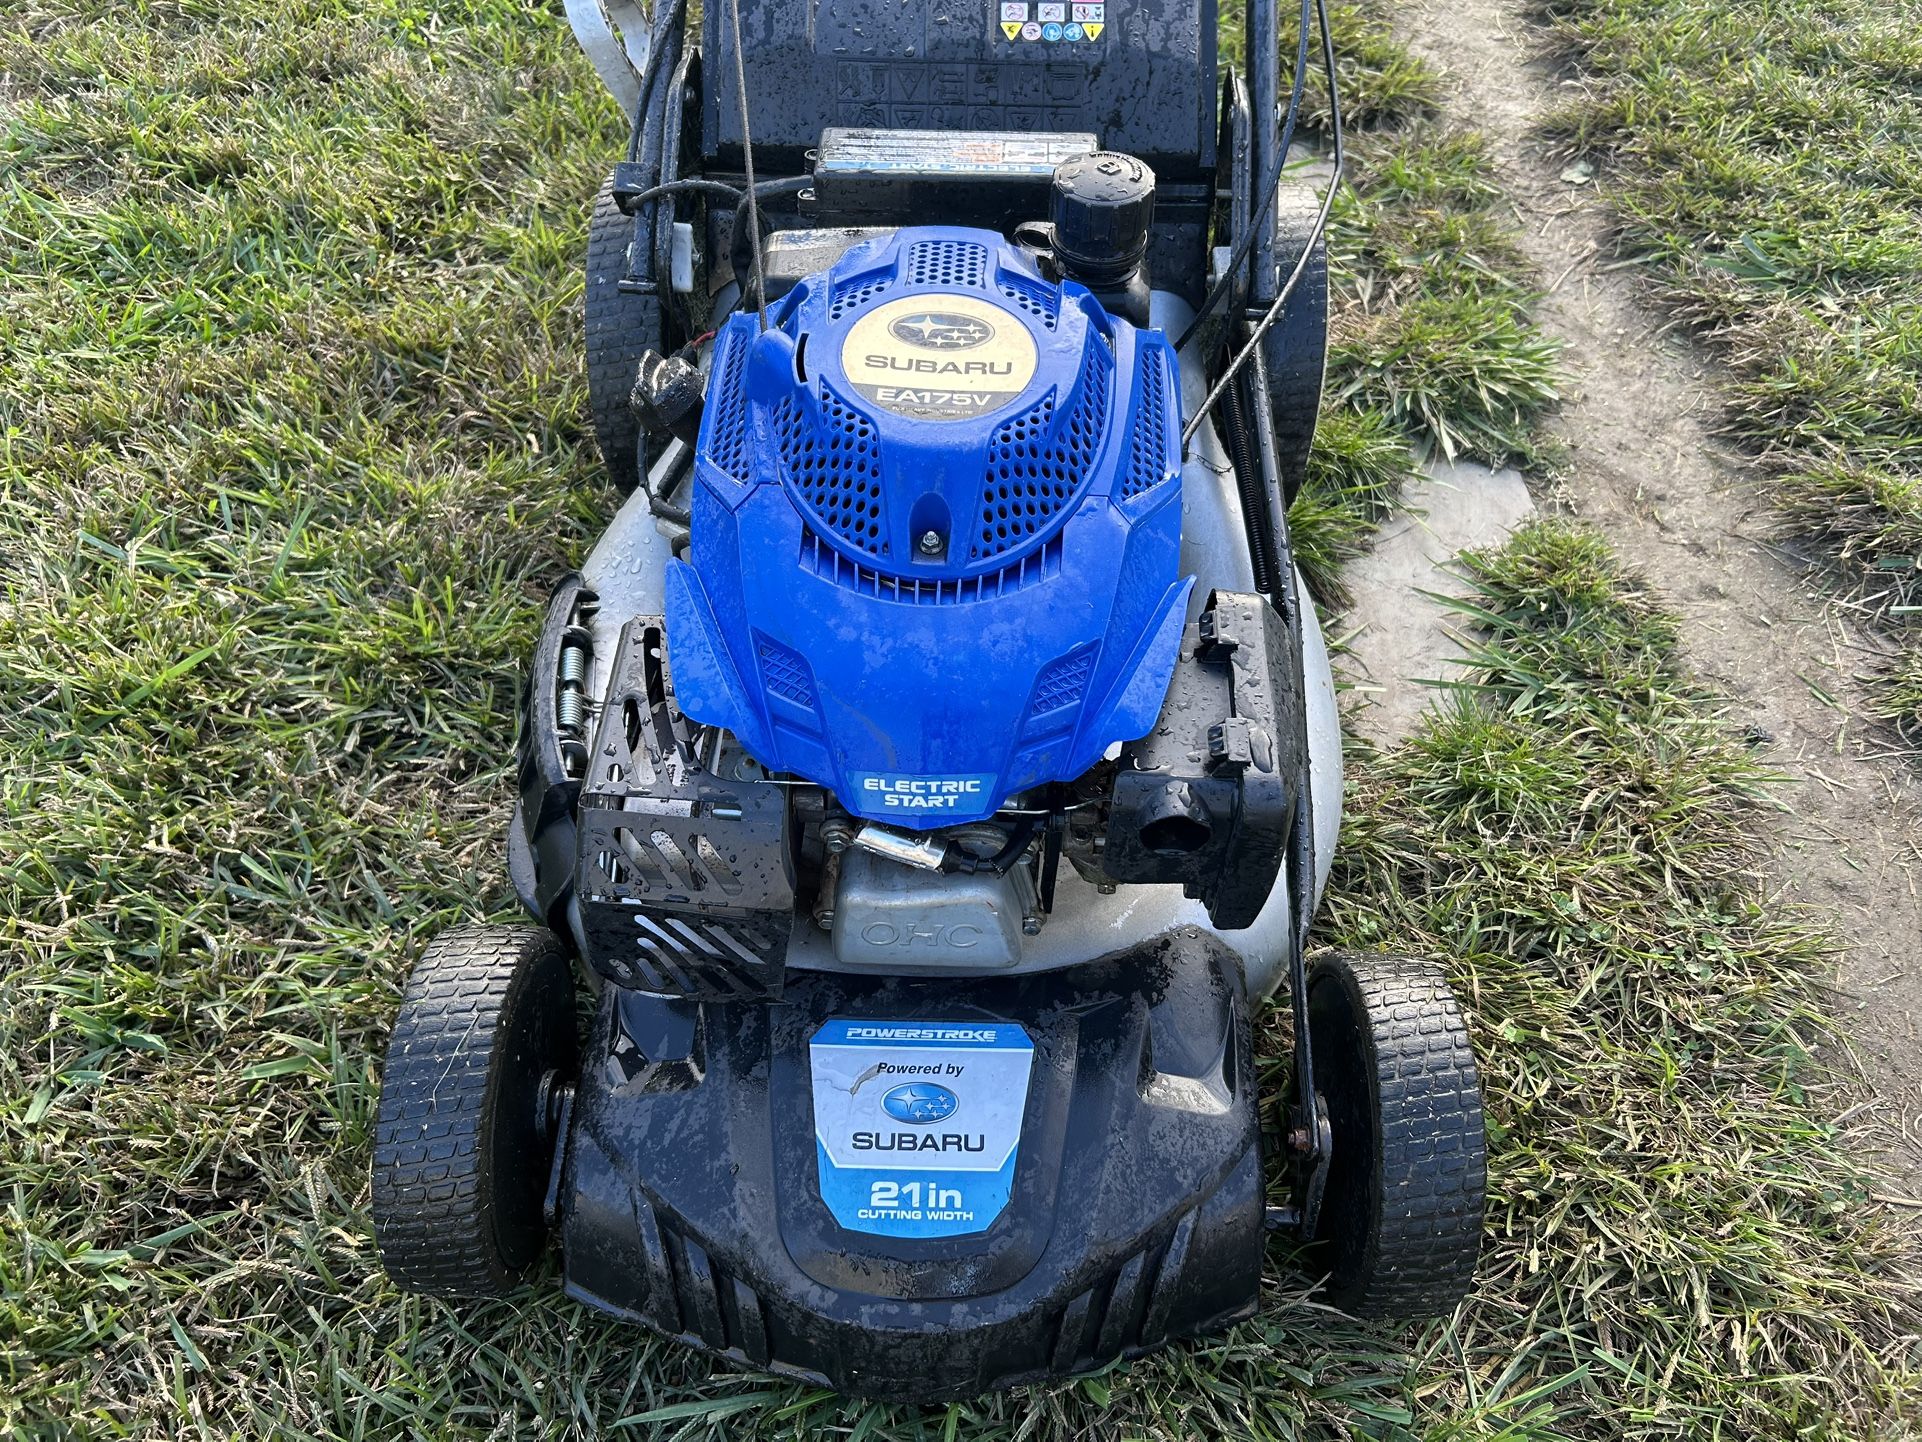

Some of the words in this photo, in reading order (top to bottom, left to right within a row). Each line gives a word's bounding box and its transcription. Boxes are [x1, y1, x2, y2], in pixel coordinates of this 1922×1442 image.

[864, 354, 1013, 375] SUBARU
[876, 387, 992, 406] EA175V
[863, 778, 981, 793] ELECTRIC
[884, 794, 959, 807] START
[861, 921, 983, 948] OHC
[846, 1027, 998, 1042] POWERSTROKE
[876, 1062, 942, 1075] Powered
[945, 1063, 964, 1077] by
[852, 1132, 985, 1152] SUBARU
[857, 1209, 922, 1220] CUTTING
[927, 1210, 974, 1221] WIDTH
